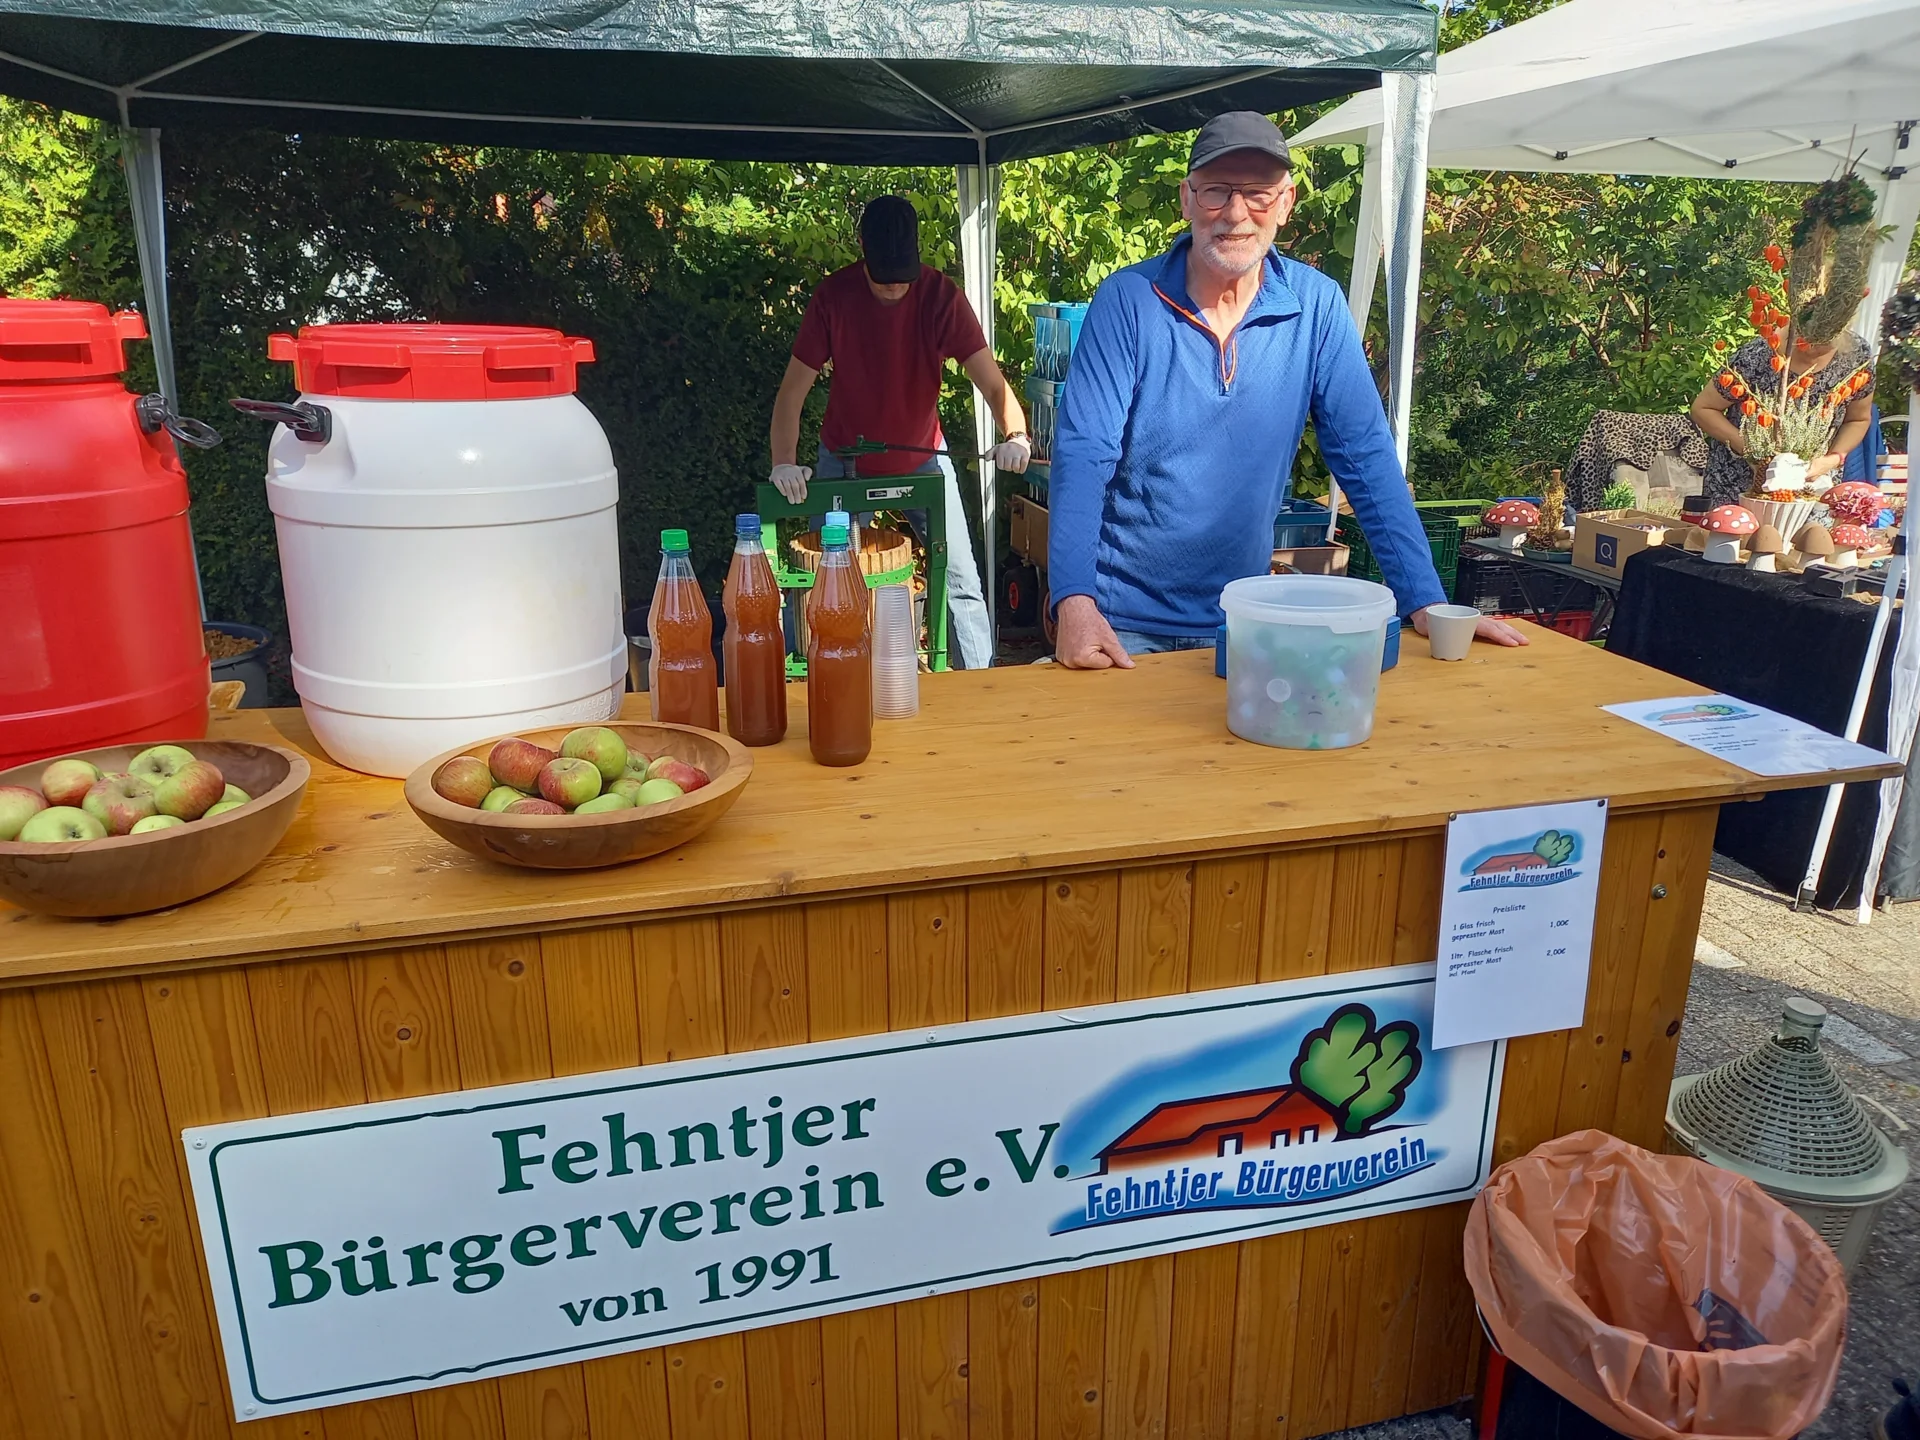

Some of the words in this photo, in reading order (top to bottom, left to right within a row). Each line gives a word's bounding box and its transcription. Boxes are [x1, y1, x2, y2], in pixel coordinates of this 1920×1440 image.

[1600, 542, 1612, 560] Q
[1470, 874, 1510, 888] Fehntjer
[1514, 868, 1573, 884] Bürgerverein
[1493, 904, 1526, 914] Preisliste
[1459, 923, 1474, 931] Glas
[1476, 919, 1496, 928] frisch
[1550, 919, 1569, 928] 1,00€
[1451, 930, 1487, 942] gepresster
[1488, 928, 1505, 936] Most
[1468, 948, 1492, 958] Flasche
[1494, 945, 1514, 954] frisch
[1546, 948, 1566, 956] 2,00€
[1449, 959, 1484, 972] gepresster
[1485, 956, 1502, 964] Most
[492, 1095, 877, 1195] Fehntjer
[1085, 1165, 1223, 1222] Fehntjer
[1233, 1134, 1429, 1199] Bürgerverein
[258, 1164, 884, 1309] Bürgerverein
[925, 1121, 1070, 1198] e.V.
[559, 1286, 668, 1327] von
[694, 1241, 840, 1305] 1991
